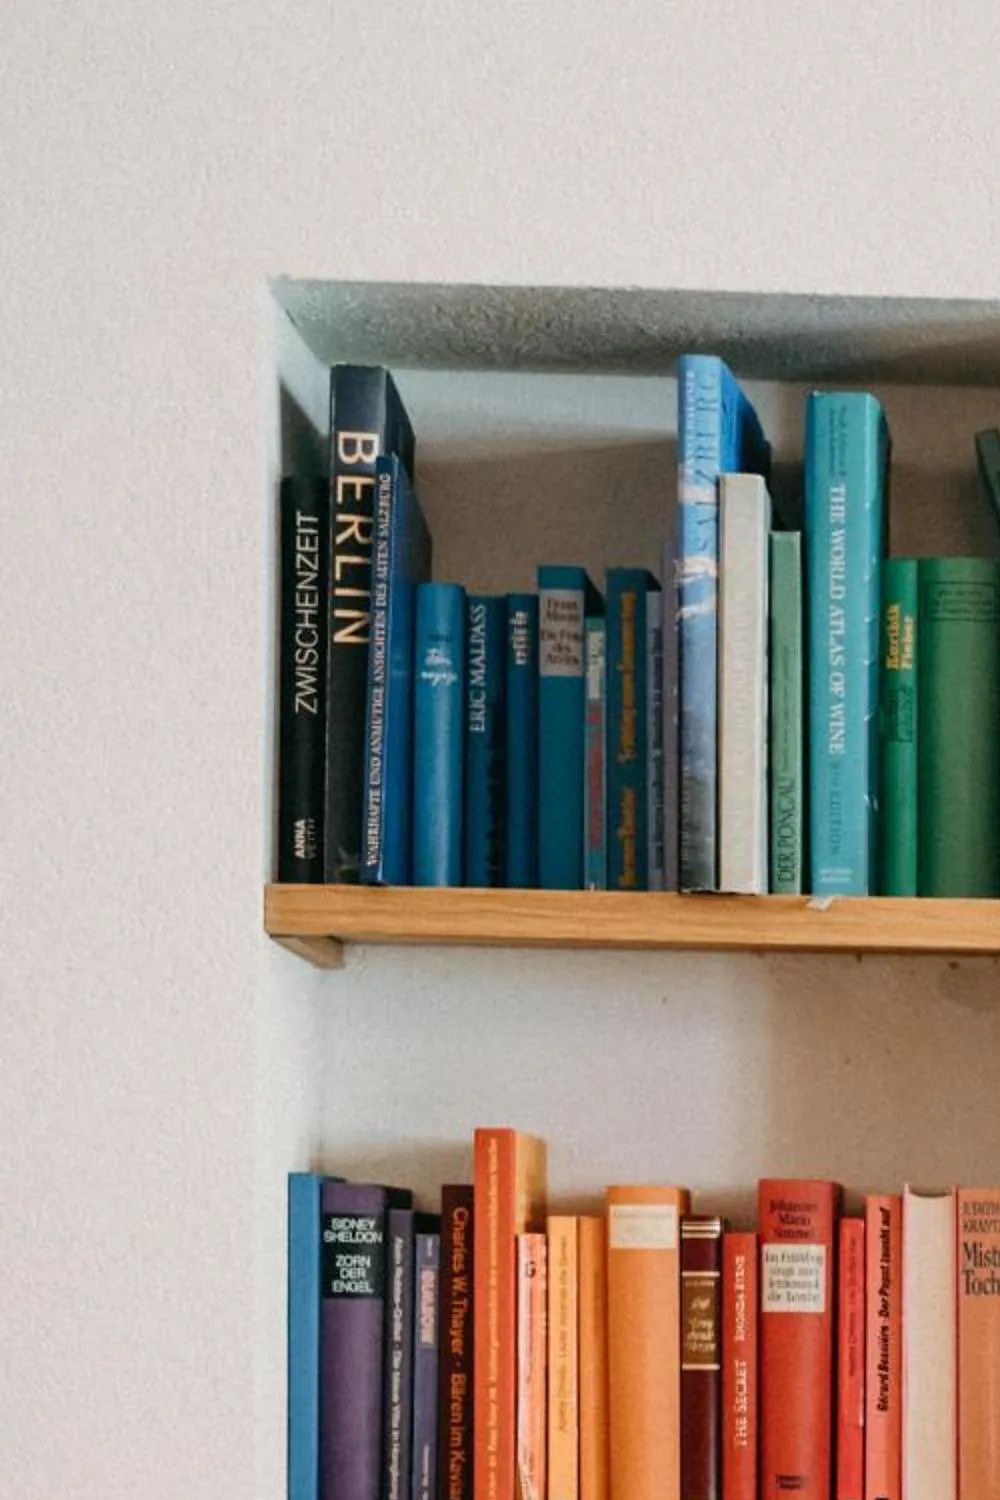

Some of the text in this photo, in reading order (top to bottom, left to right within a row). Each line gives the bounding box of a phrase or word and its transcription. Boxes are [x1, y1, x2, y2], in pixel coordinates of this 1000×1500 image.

[829, 483, 848, 524] THE
[333, 430, 380, 645] BERLIN
[829, 528, 847, 600] WORLD
[294, 510, 319, 714] ZWISCHENZEIT
[828, 604, 846, 667] ATLAS
[366, 473, 392, 866] WAHRHAFTE UND ANMUTIGE ANSICHTEN DES ALTEN SALZBURG
[468, 603, 487, 733] ERIC MALPASS
[828, 671, 846, 699] OF
[828, 703, 846, 756] WINE
[776, 776, 795, 847] PONGAU
[294, 818, 305, 858] ANNA
[777, 847, 795, 883] DER
[323, 1230, 384, 1244] SHELDON
[331, 1217, 376, 1231] SIDNEY
[452, 1206, 470, 1272] Charles
[335, 1254, 372, 1268] ZORN
[331, 1280, 374, 1294] ENGEL
[878, 1298, 890, 1318] Der
[450, 1299, 469, 1356] Thayer
[451, 1373, 467, 1423] Bären
[733, 1359, 747, 1413] SECRET
[734, 1417, 747, 1446] THE
